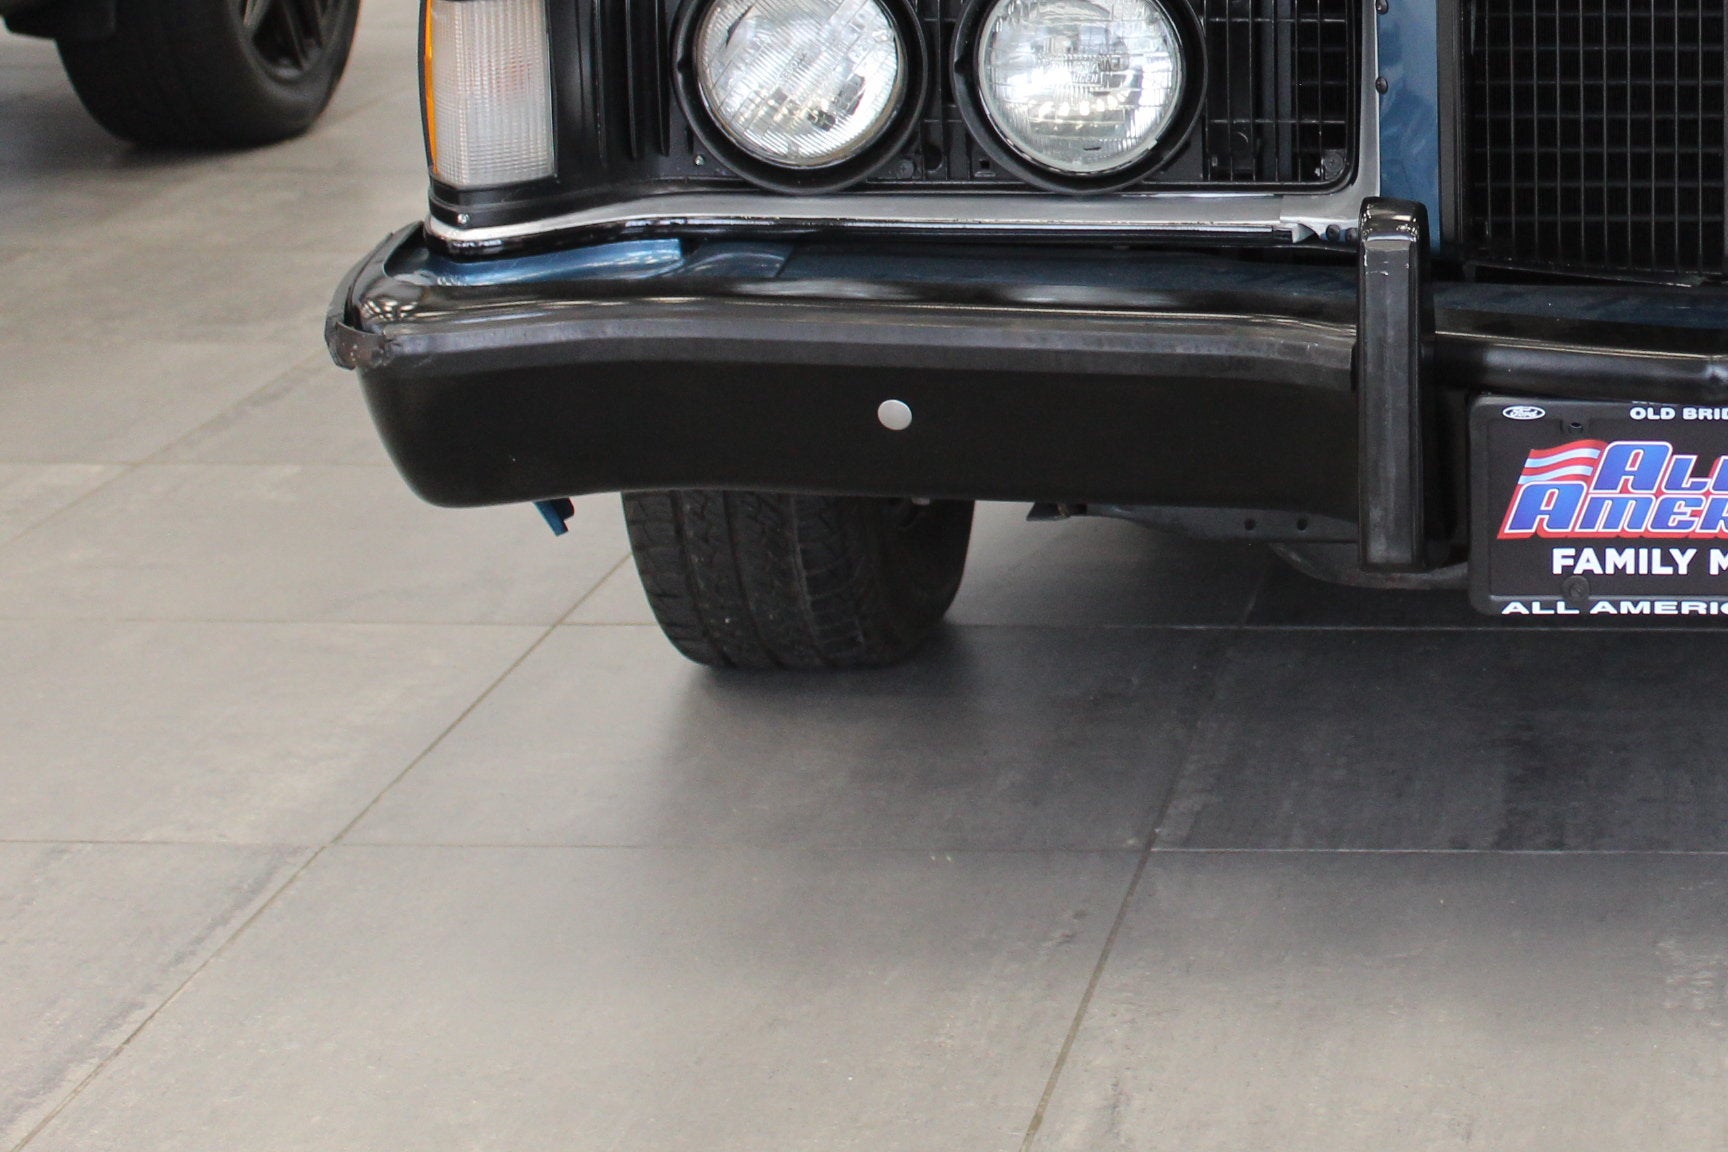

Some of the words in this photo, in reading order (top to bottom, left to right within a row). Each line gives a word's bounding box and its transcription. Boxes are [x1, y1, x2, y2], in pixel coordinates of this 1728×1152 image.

[1630, 406, 1678, 421] OLD
[1552, 547, 1697, 575] FAMILY
[1501, 600, 1580, 616] ALL
